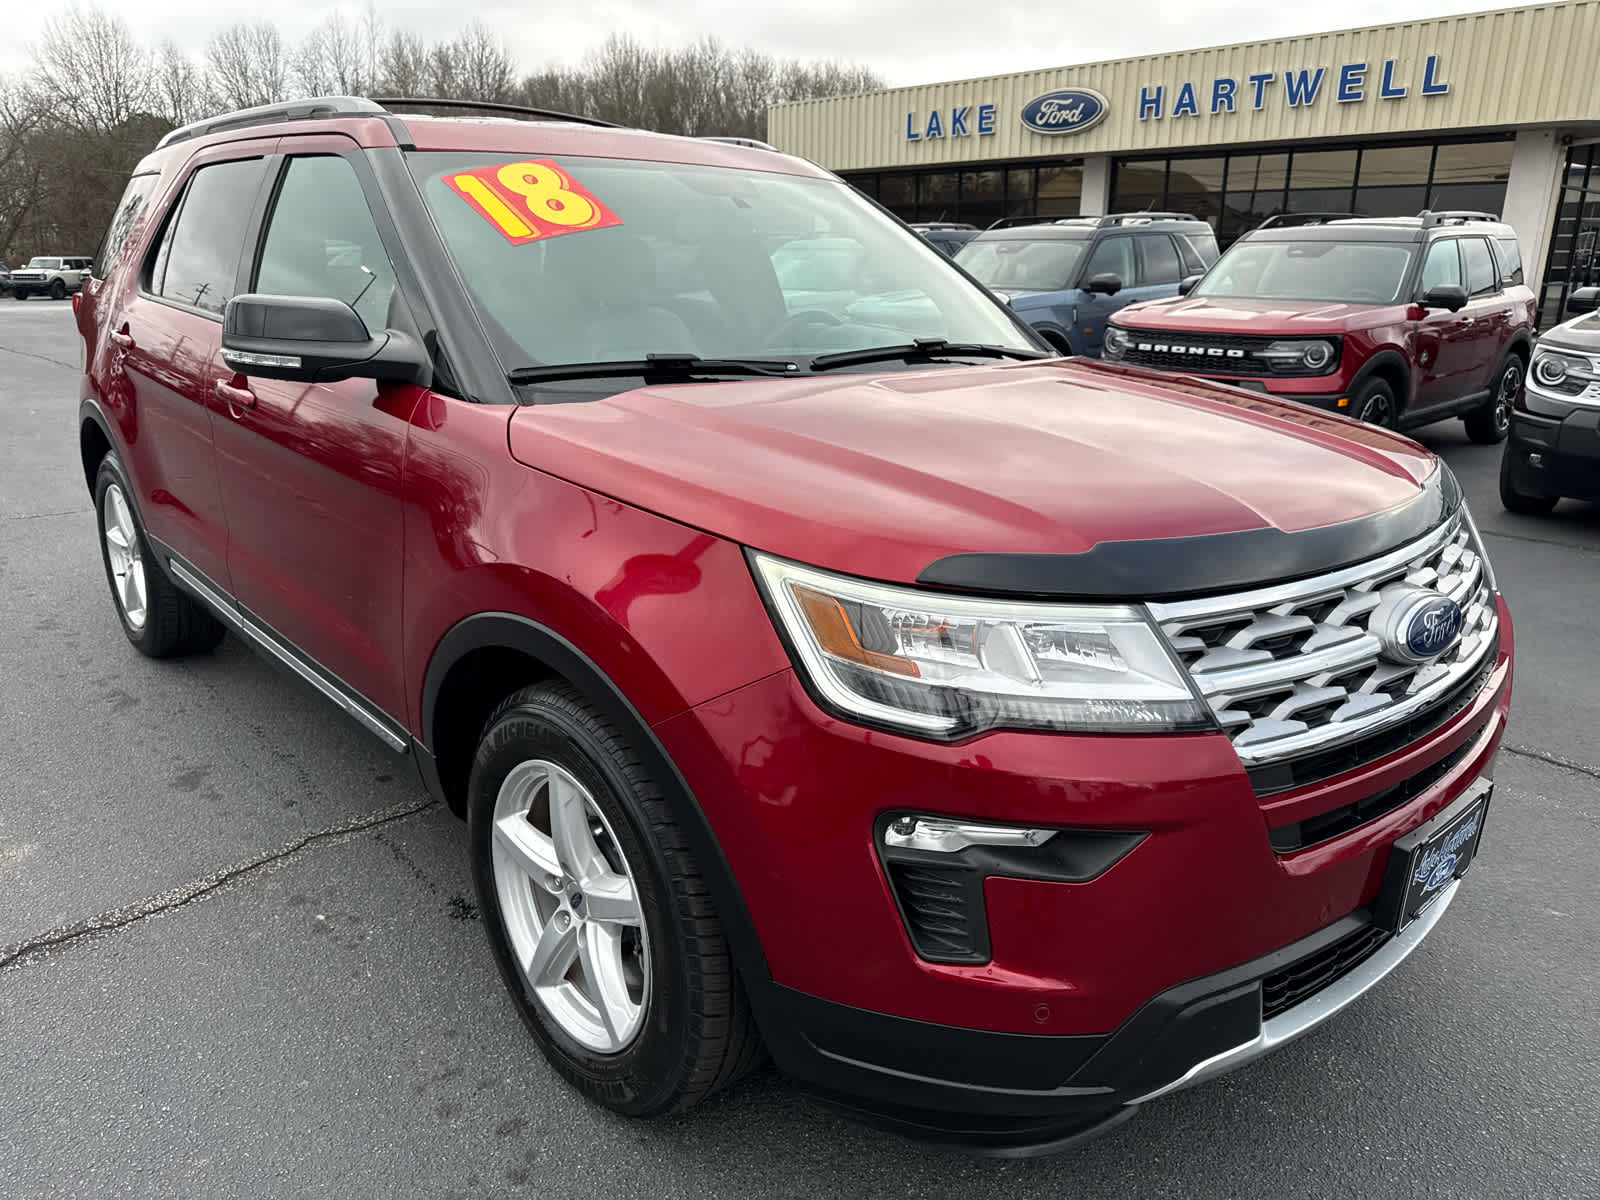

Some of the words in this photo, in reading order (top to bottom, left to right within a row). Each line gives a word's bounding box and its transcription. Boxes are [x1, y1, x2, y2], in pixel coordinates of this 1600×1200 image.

[906, 103, 995, 142] LAKE
[1035, 98, 1085, 126] Ford
[1138, 54, 1450, 120] HARTWELL
[454, 162, 600, 238] 18
[1137, 343, 1245, 358] BRONCO
[1423, 606, 1457, 649] Ford
